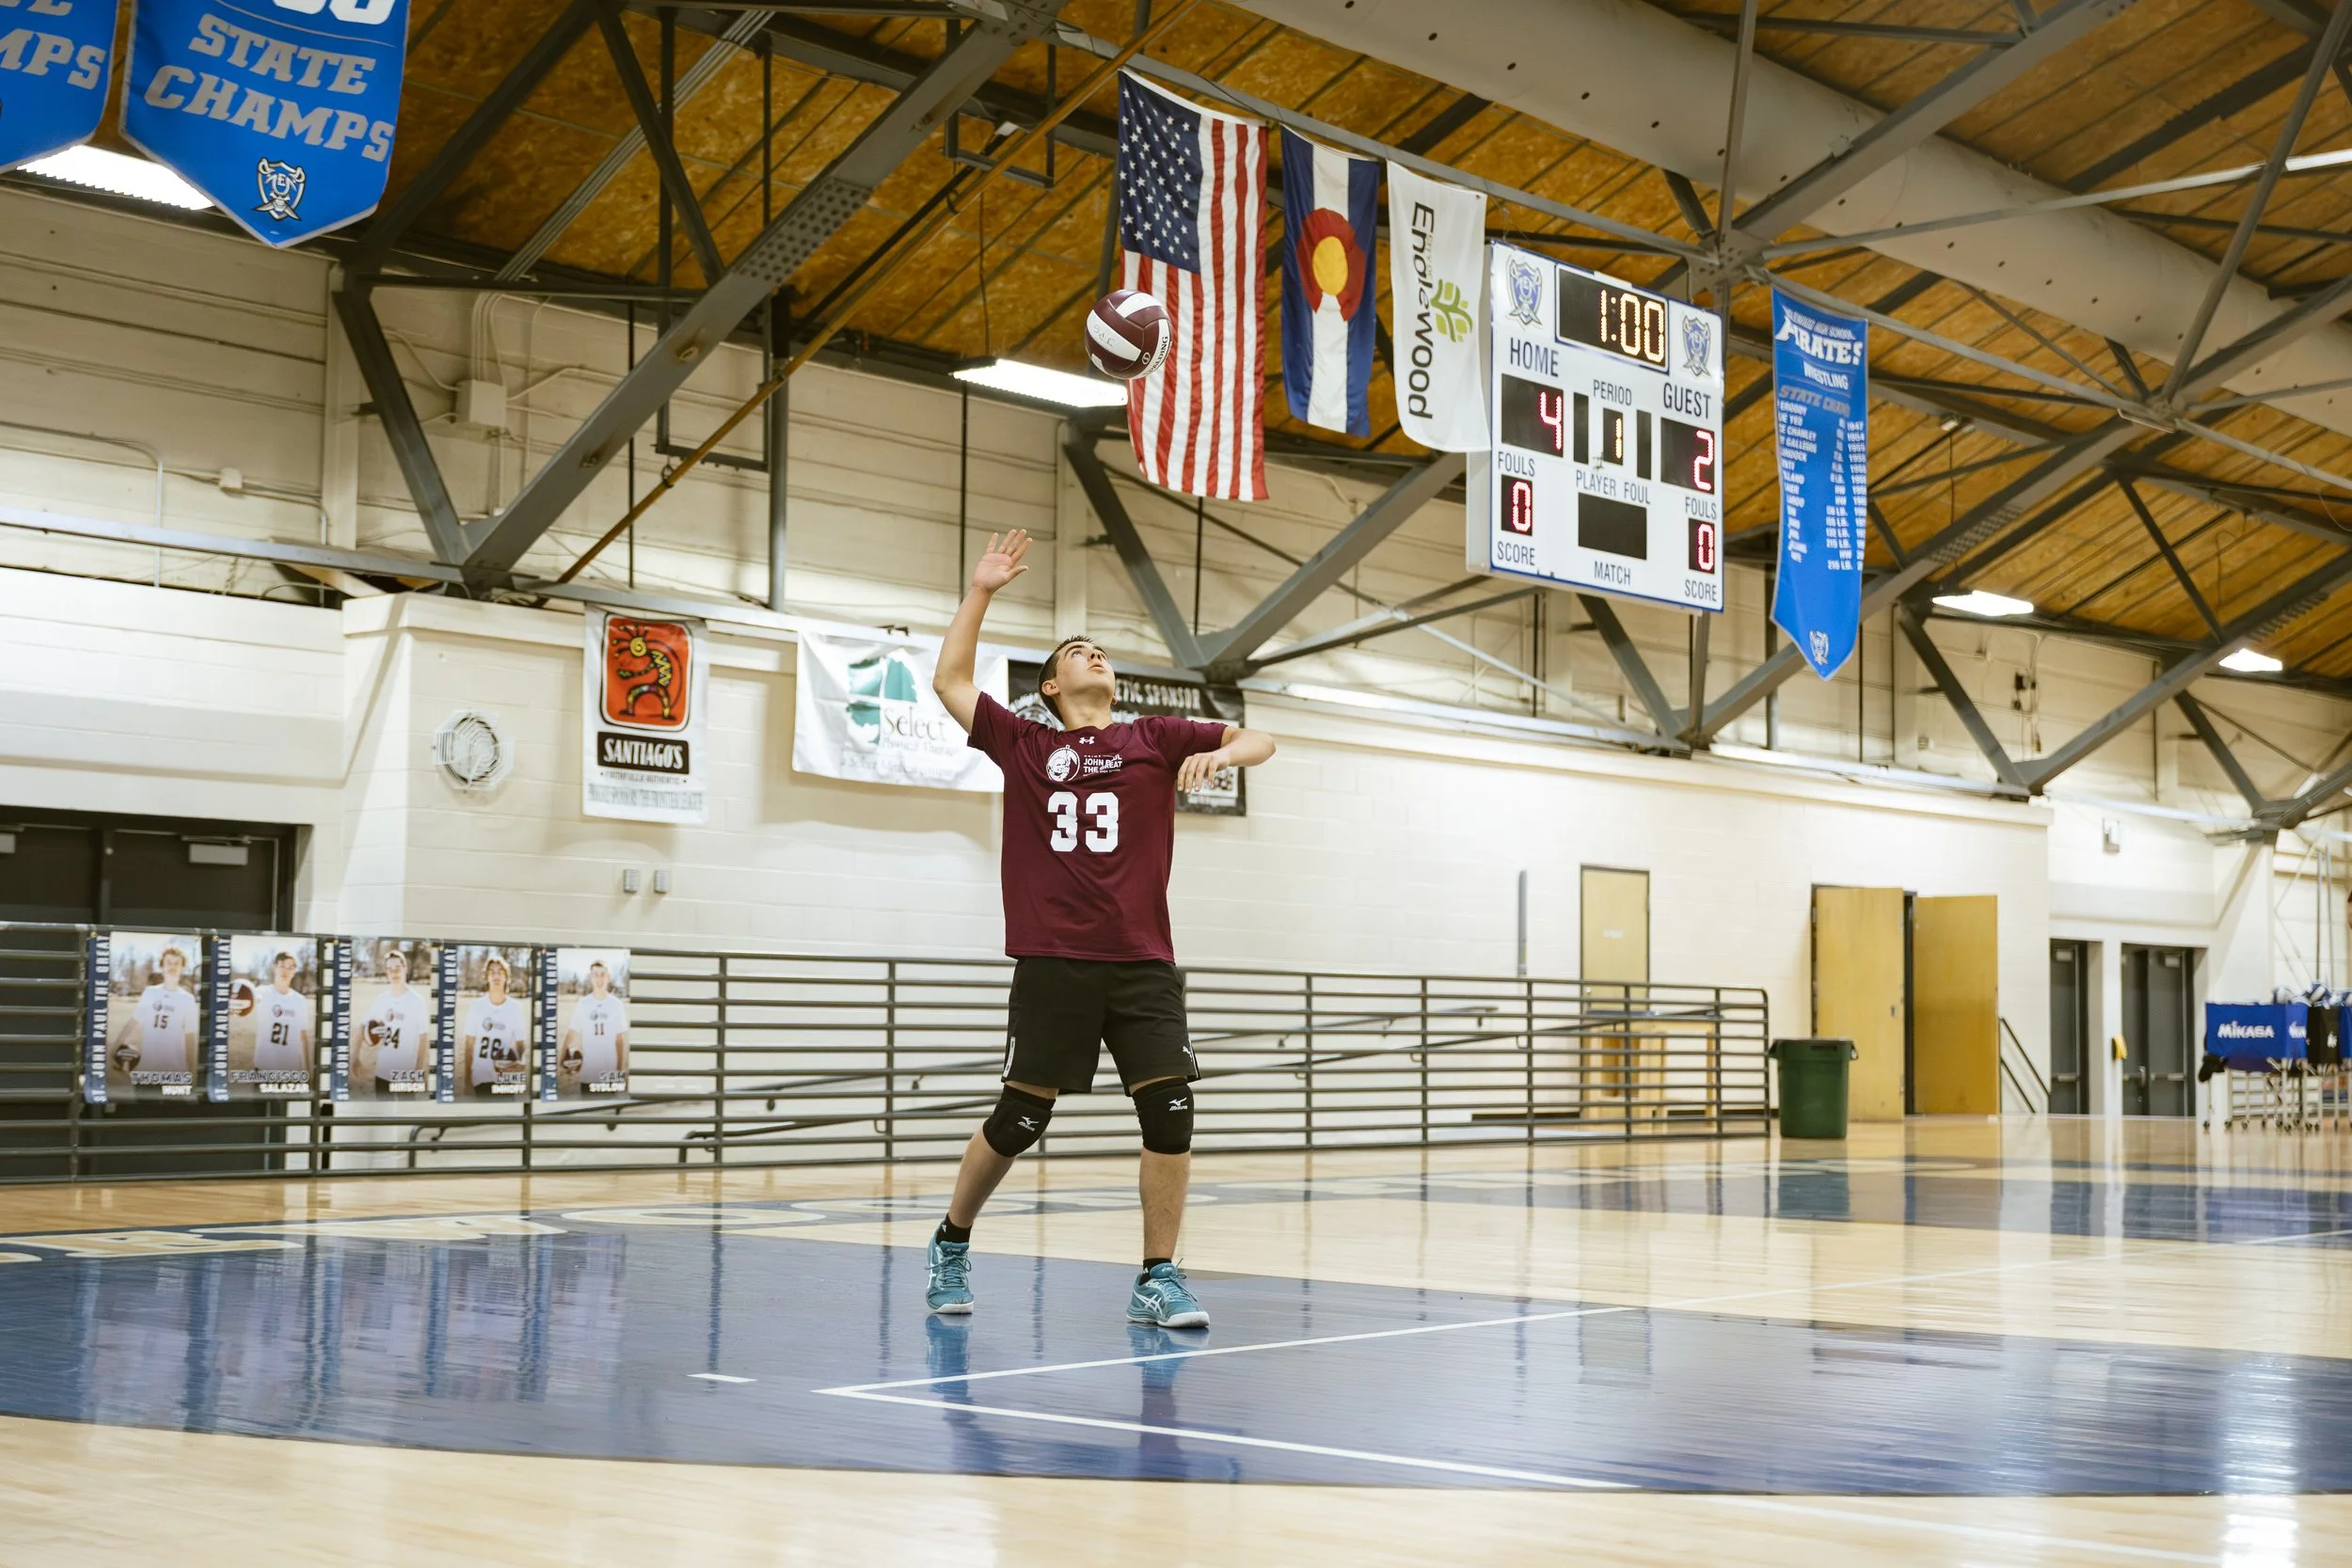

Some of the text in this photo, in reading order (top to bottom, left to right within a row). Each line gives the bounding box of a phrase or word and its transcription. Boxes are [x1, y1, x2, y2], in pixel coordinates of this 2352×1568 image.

[188, 12, 376, 95] STATE
[144, 65, 394, 162] CHAMPS
[1600, 289, 1664, 363] 1:00
[1510, 337, 1559, 377] HOME
[1593, 379, 1632, 406] PERIOD
[1663, 382, 1711, 420] GUEST
[1540, 391, 1562, 451] 4
[1615, 418, 1623, 459] 1
[1498, 451, 1535, 477] FOULS
[1693, 430, 1714, 491] 2
[1576, 469, 1651, 505] PLAYER FOUL
[1512, 481, 1532, 532] 0
[1685, 497, 1717, 520] FOULS
[1498, 541, 1535, 566] SCORE
[1698, 523, 1714, 571] 0
[1594, 561, 1630, 585] MATCH
[1685, 578, 1717, 602] SCORE
[1144, 683, 1200, 710] SPONSOR
[883, 705, 947, 741] Select
[1047, 791, 1119, 853] 33
[96, 936, 110, 973] GREAT
[217, 939, 230, 974] GREAT
[339, 942, 351, 977] GREAT
[444, 948, 456, 983] GREAT
[548, 951, 557, 985] GREAT
[94, 980, 108, 1001] THE
[216, 982, 230, 1002] THE
[338, 985, 350, 1004] THE
[443, 990, 455, 1008] THE
[547, 991, 557, 1009] THE
[93, 1008, 107, 1037] PAUL
[153, 1014, 167, 1029] 15
[215, 1009, 229, 1038] PAUL
[271, 1022, 290, 1046] 21
[337, 1010, 349, 1038] PAUL
[442, 1014, 454, 1042] PAUL
[547, 1016, 556, 1042] PAUL
[594, 1022, 605, 1036] 11
[91, 1045, 105, 1077] JOHN
[215, 1045, 228, 1076] JOHN
[336, 1045, 349, 1076] JOHN
[441, 1049, 453, 1078] JOHN
[546, 1049, 556, 1078] JOHN
[131, 1070, 193, 1085] THOMAS
[229, 1069, 310, 1084] FRANCISCO
[260, 1084, 310, 1094] SALAZAR
[391, 1070, 425, 1081] ZACH
[496, 1072, 527, 1083] LUKE
